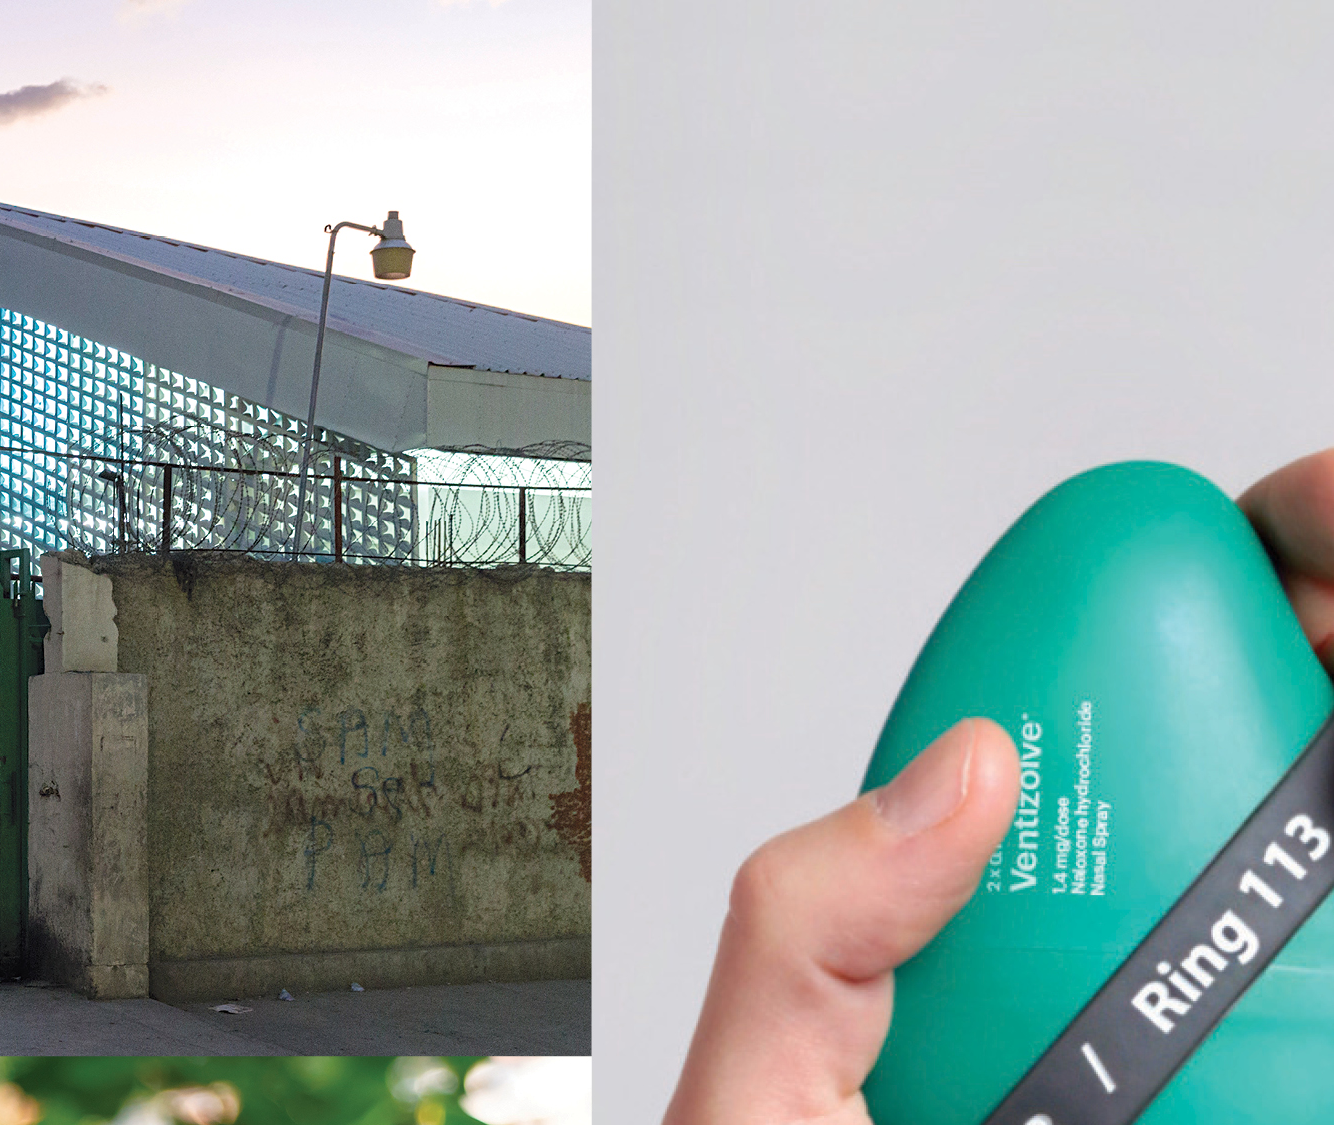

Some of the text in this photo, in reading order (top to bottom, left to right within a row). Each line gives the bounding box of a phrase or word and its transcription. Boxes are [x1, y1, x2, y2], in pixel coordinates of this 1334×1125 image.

[1053, 797, 1072, 870] mg/dose
[1070, 701, 1093, 895] Naloxone hydrochloride
[1089, 799, 1112, 895] Nasal Spray
[1130, 908, 1261, 1034] Ring
[1238, 813, 1332, 910] 113
